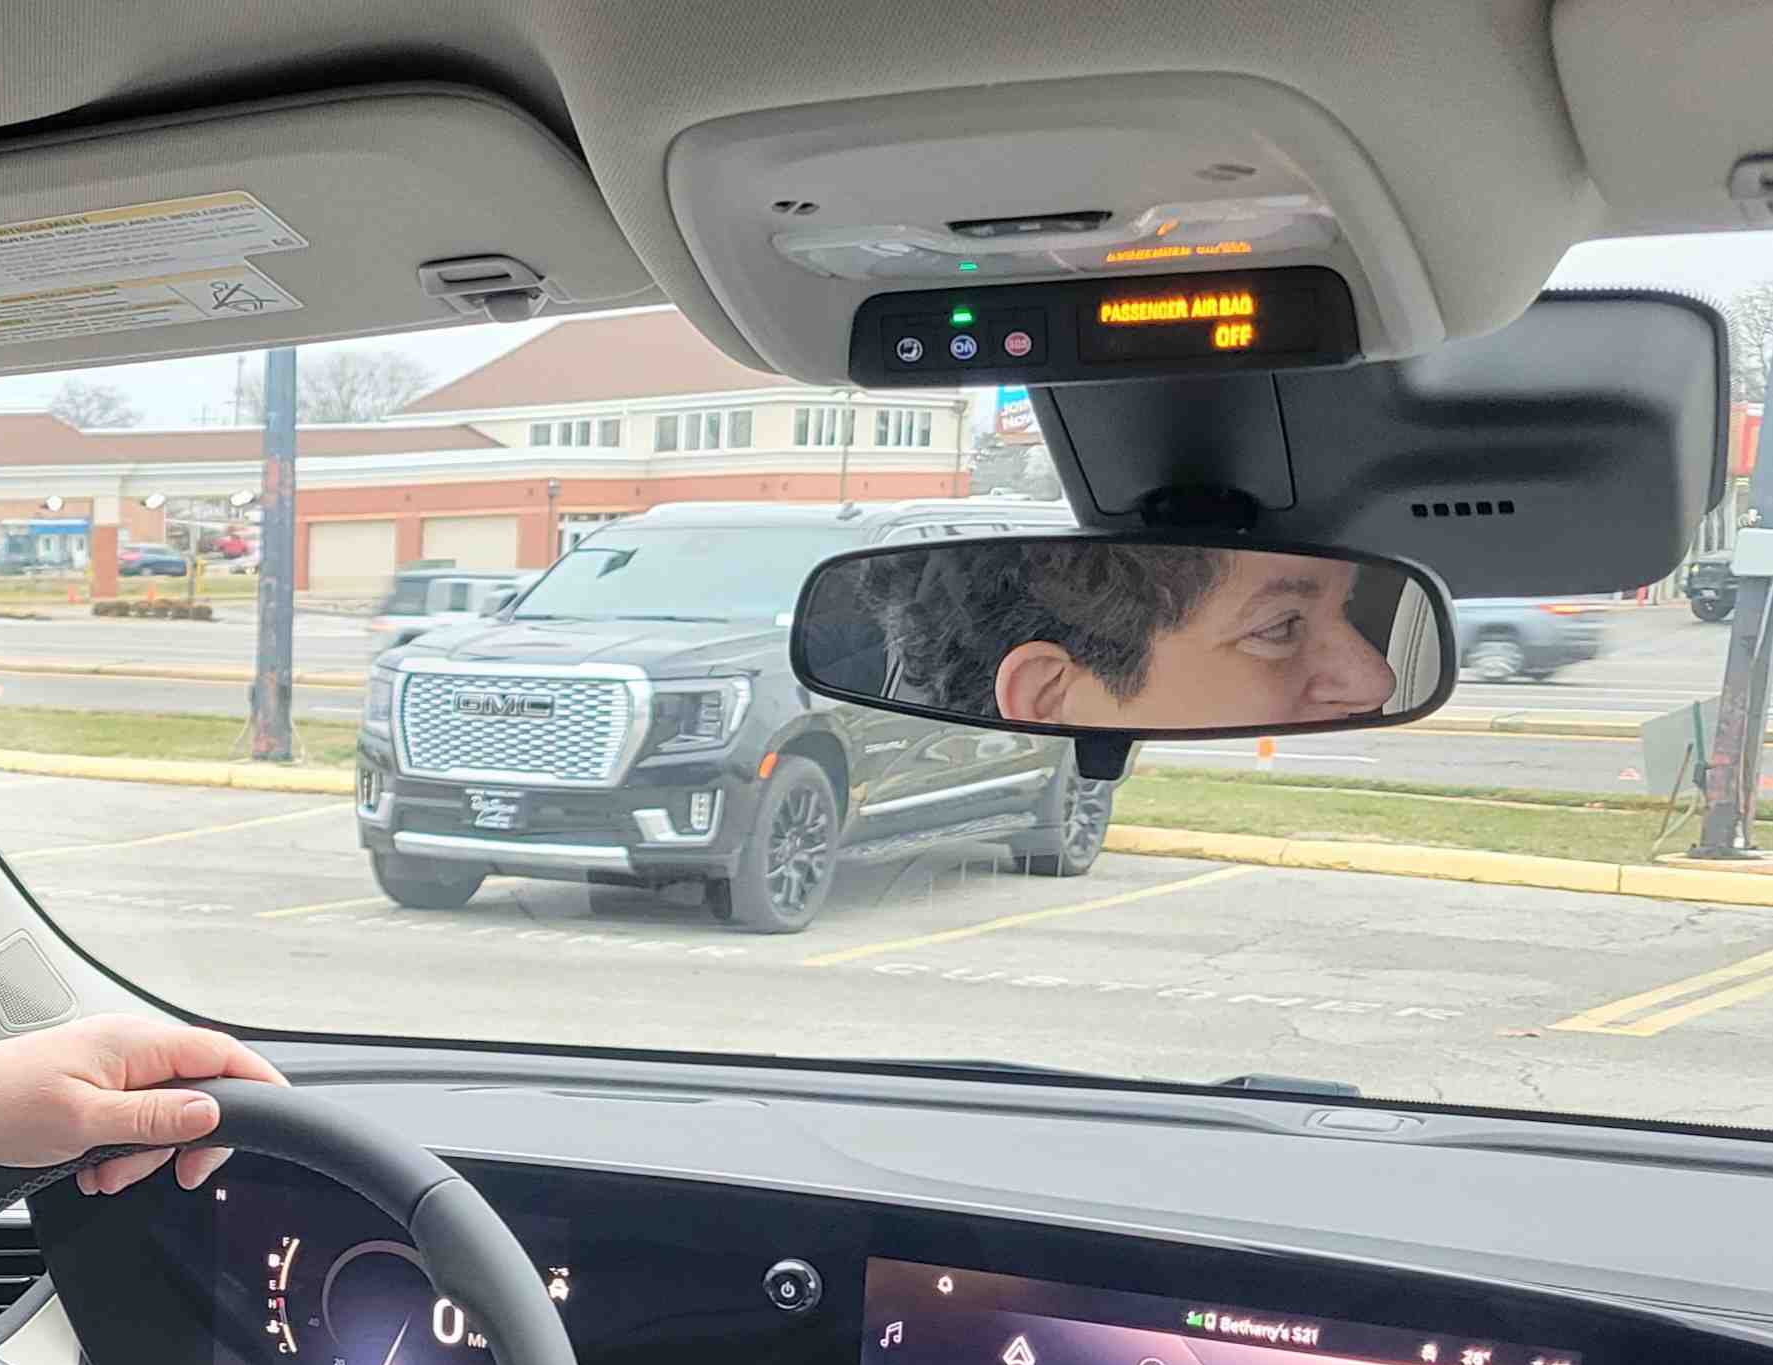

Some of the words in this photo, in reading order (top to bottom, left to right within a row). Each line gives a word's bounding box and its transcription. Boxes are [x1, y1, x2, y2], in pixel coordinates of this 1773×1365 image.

[1100, 299, 1189, 323] PASSENGER
[1191, 296, 1218, 318] AIR
[1219, 293, 1254, 317] BAG
[1215, 322, 1254, 348] OFF
[458, 691, 552, 717] GMC
[215, 1189, 227, 1201] N
[281, 1236, 291, 1247] F
[269, 1279, 278, 1290] E
[268, 1299, 277, 1309] H
[432, 1298, 464, 1344] 0
[1291, 1326, 1320, 1346] S21
[279, 1343, 288, 1353] C
